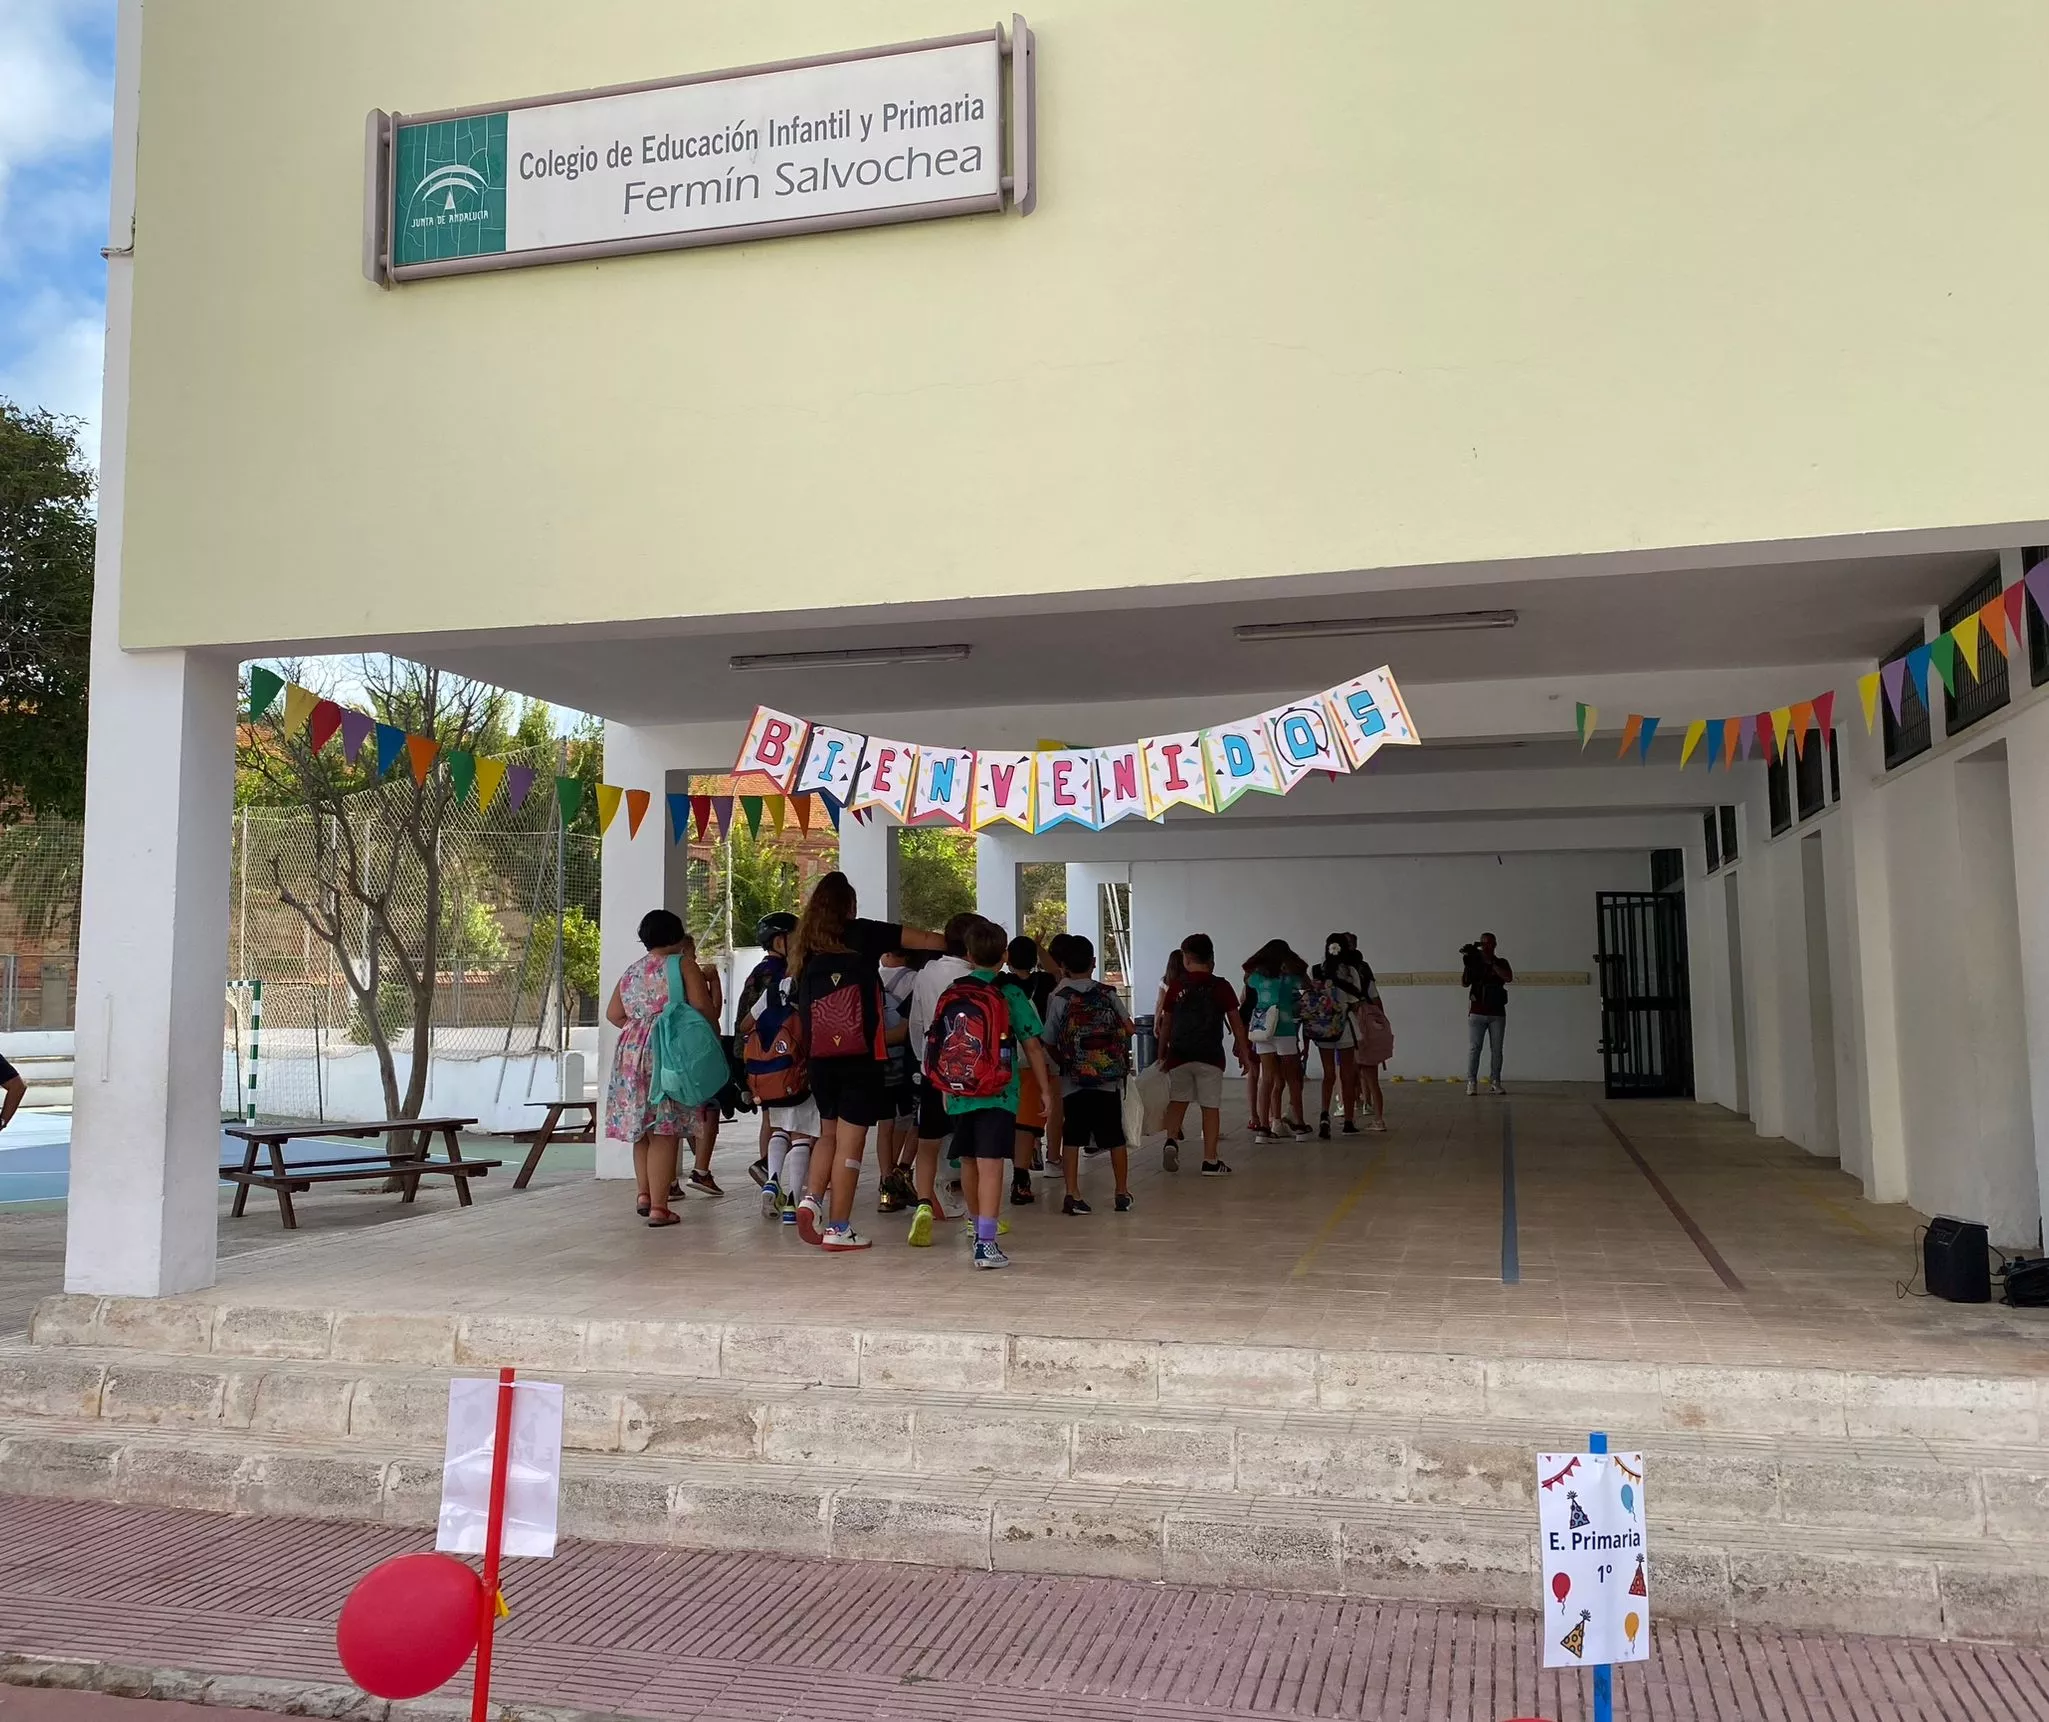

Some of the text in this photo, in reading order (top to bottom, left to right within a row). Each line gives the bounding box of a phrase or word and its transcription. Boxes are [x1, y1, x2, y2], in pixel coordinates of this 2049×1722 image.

[519, 93, 984, 180] Colegio de Educación Infantil y Primaria
[624, 144, 982, 215] Fermín Salvochea
[411, 216, 434, 228] JUNTA
[437, 215, 446, 225] DE
[1550, 1528, 1640, 1550] E. Primaria
